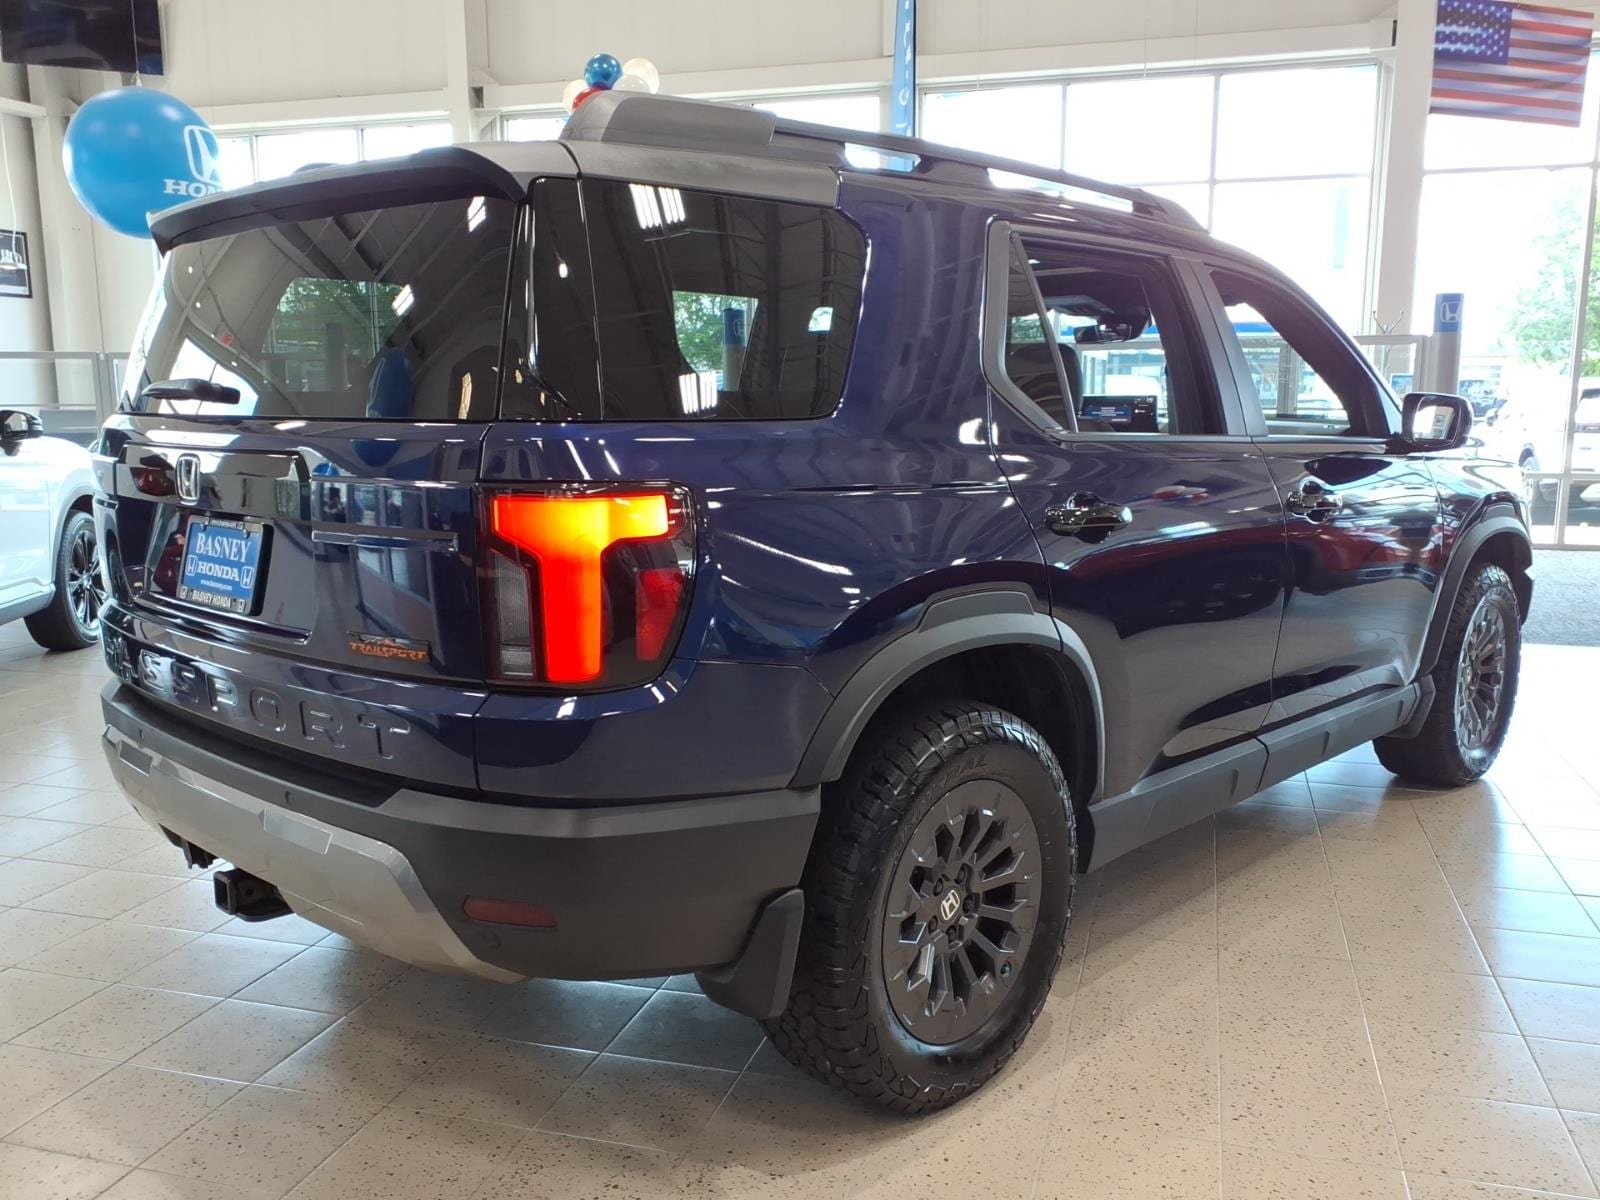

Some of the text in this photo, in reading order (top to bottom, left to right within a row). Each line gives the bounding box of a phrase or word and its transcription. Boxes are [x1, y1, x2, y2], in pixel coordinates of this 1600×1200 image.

[196, 532, 251, 563] BASNEY
[197, 561, 240, 582] HONDA
[192, 590, 231, 608] BASNEY HONDA
[349, 641, 428, 661] TRAILSPORT
